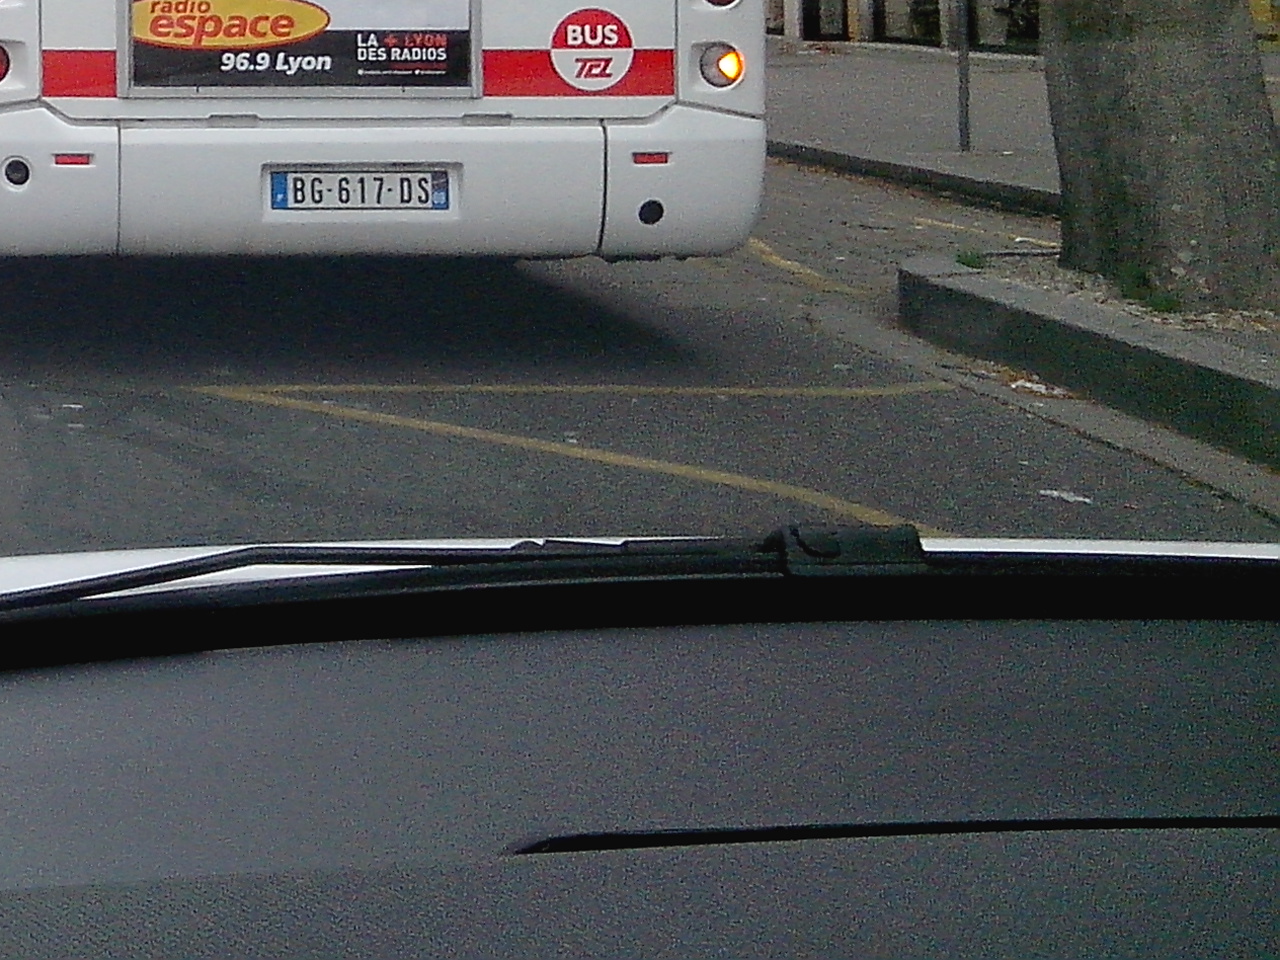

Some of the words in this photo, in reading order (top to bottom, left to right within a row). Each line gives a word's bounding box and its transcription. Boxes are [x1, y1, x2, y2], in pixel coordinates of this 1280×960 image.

[149, 12, 295, 48] espace
[357, 33, 379, 47] LA
[404, 33, 448, 47] LYON
[566, 24, 619, 46] BUS
[220, 52, 270, 72] 96.9
[275, 51, 332, 76] Lyon
[357, 47, 387, 61] DES
[390, 47, 448, 61] RADIOS
[574, 56, 613, 79] TCL
[292, 176, 430, 205] BG-617-DS
